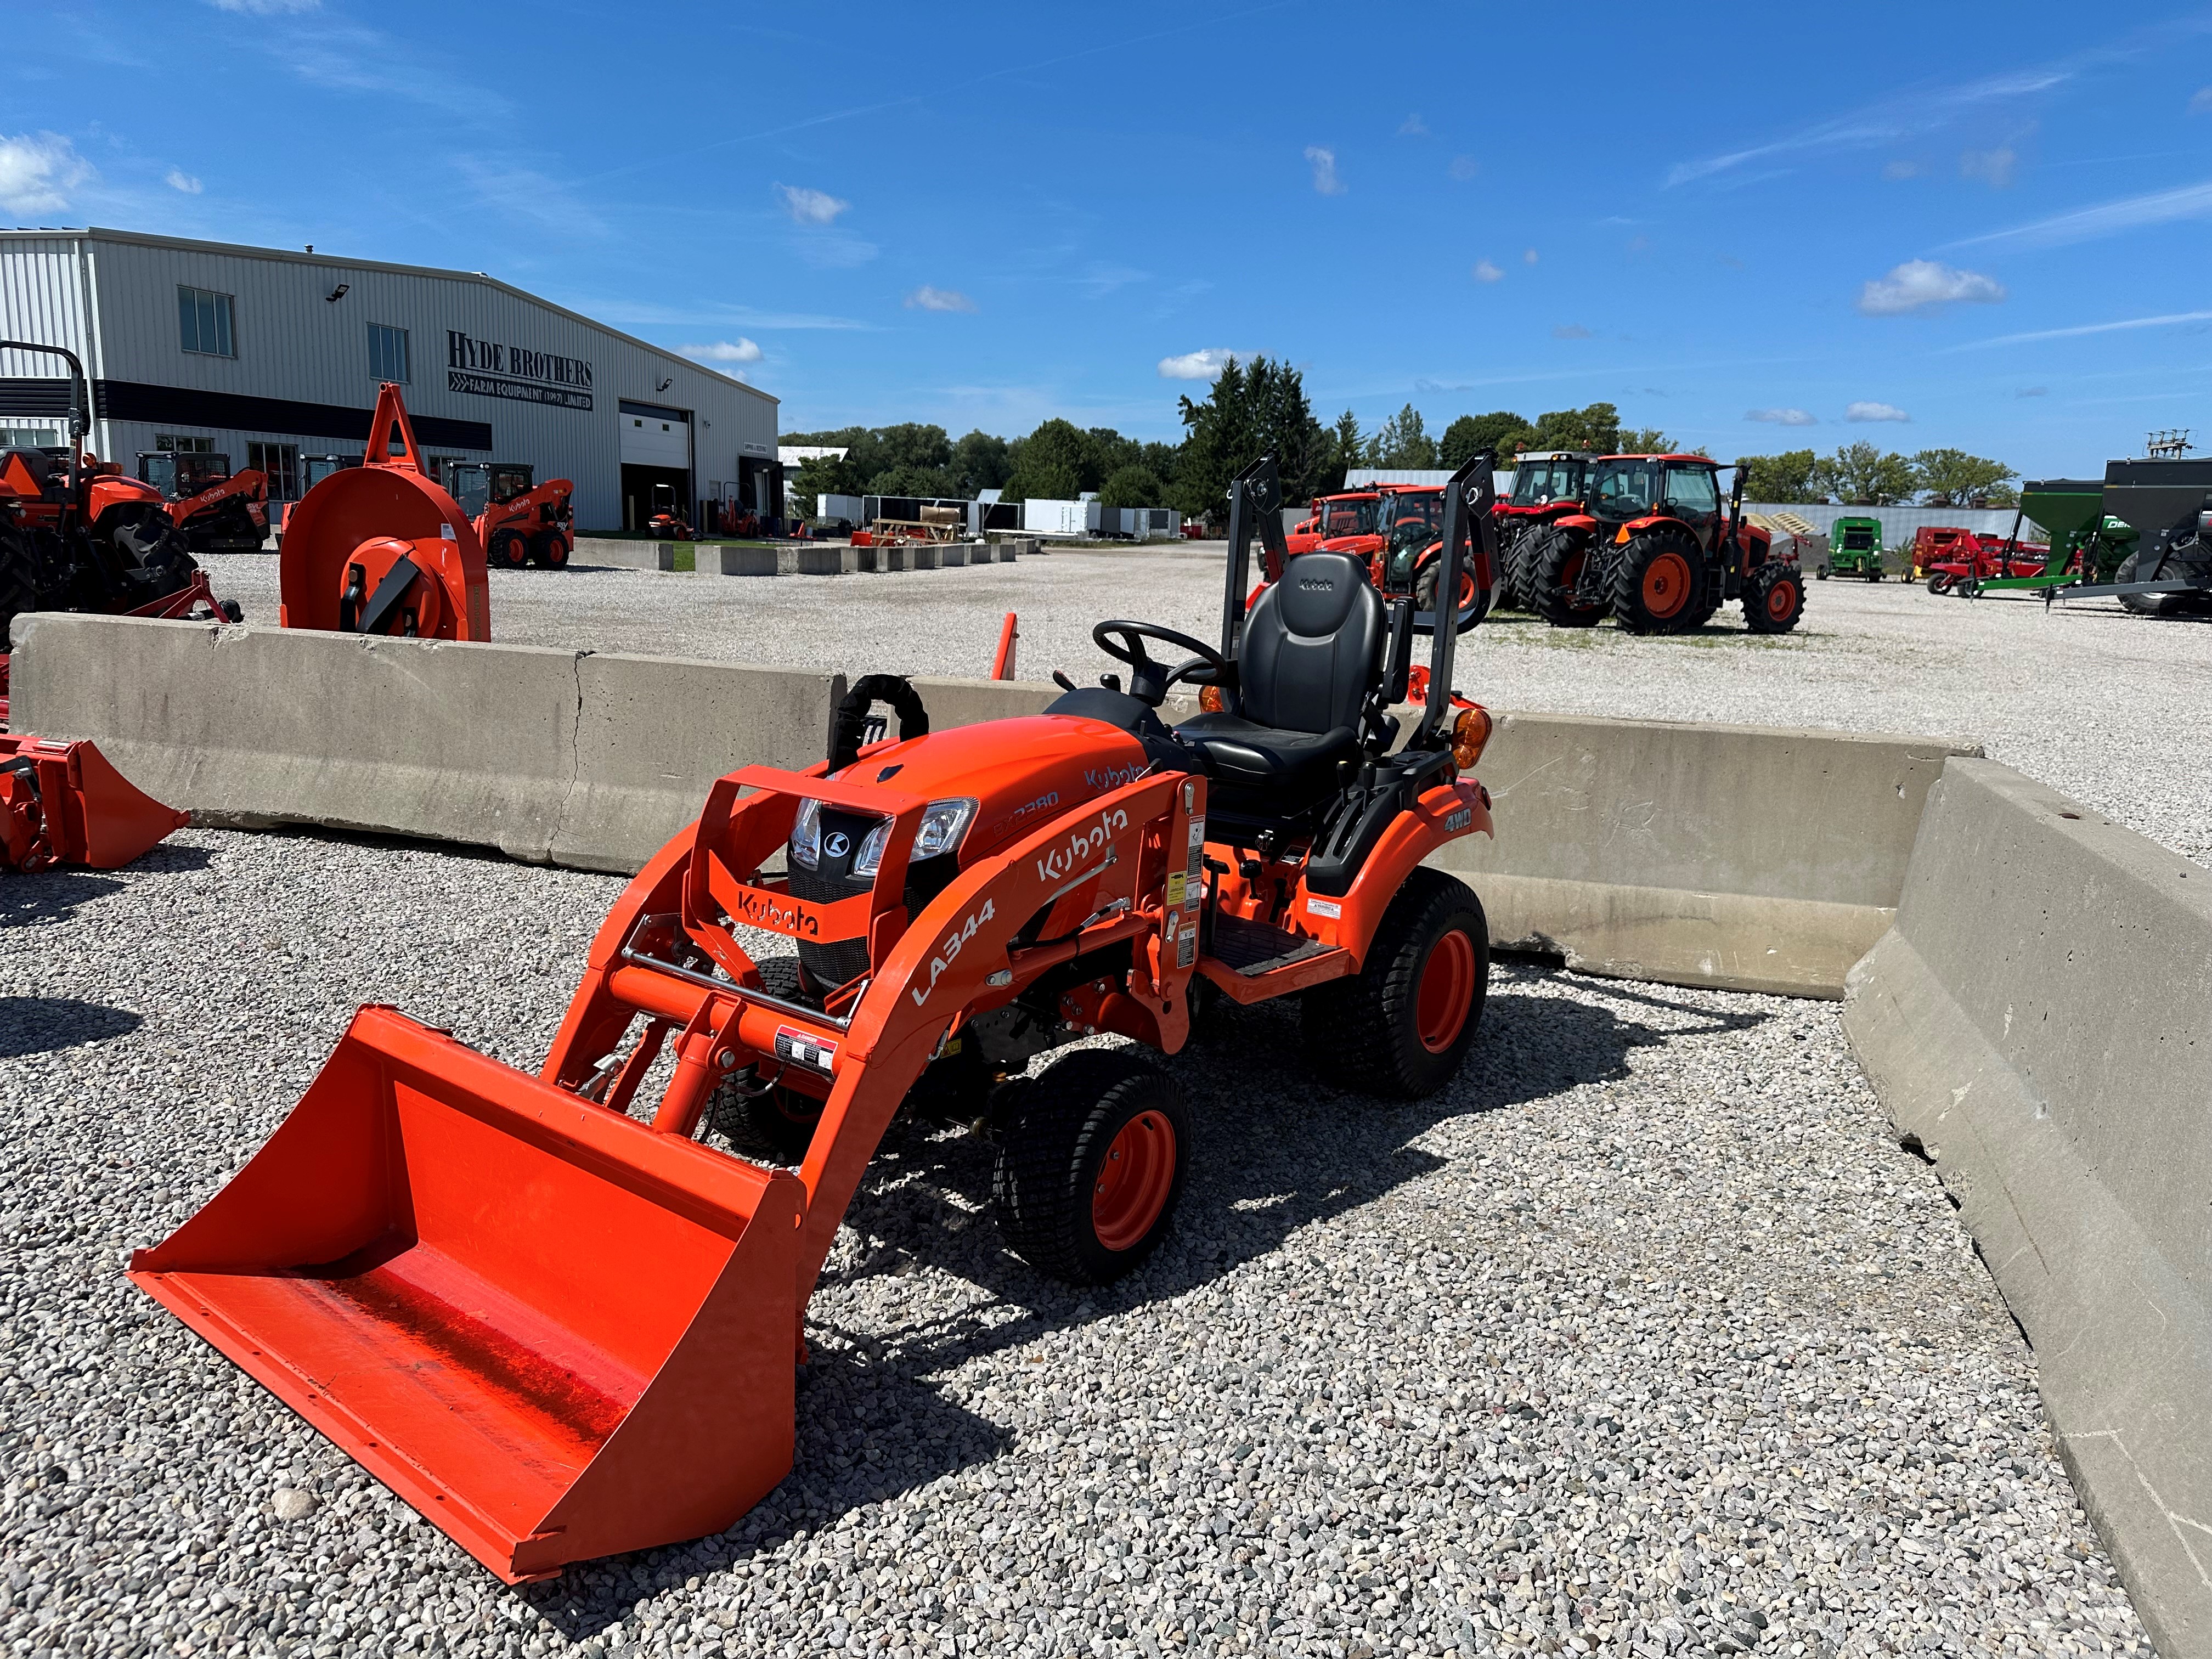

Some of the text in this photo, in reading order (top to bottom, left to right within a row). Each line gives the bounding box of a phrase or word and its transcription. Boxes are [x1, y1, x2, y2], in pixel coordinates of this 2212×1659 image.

[447, 330, 592, 387] HYDE BROTHERS
[470, 379, 494, 394] FARM
[496, 382, 542, 401] EQUIPMENT
[564, 394, 591, 408] LIMITED
[200, 489, 225, 503] Kubota
[509, 498, 530, 512] Kubota
[1299, 579, 1333, 591] Kubota
[1084, 762, 1144, 789] Kubota
[992, 792, 1059, 837] BX2380
[1444, 808, 1471, 832] 4WD
[1037, 809, 1128, 882] Kubota
[738, 891, 818, 935] Kubota
[912, 898, 995, 1006] LA344
[801, 1034, 818, 1043] DANGER
